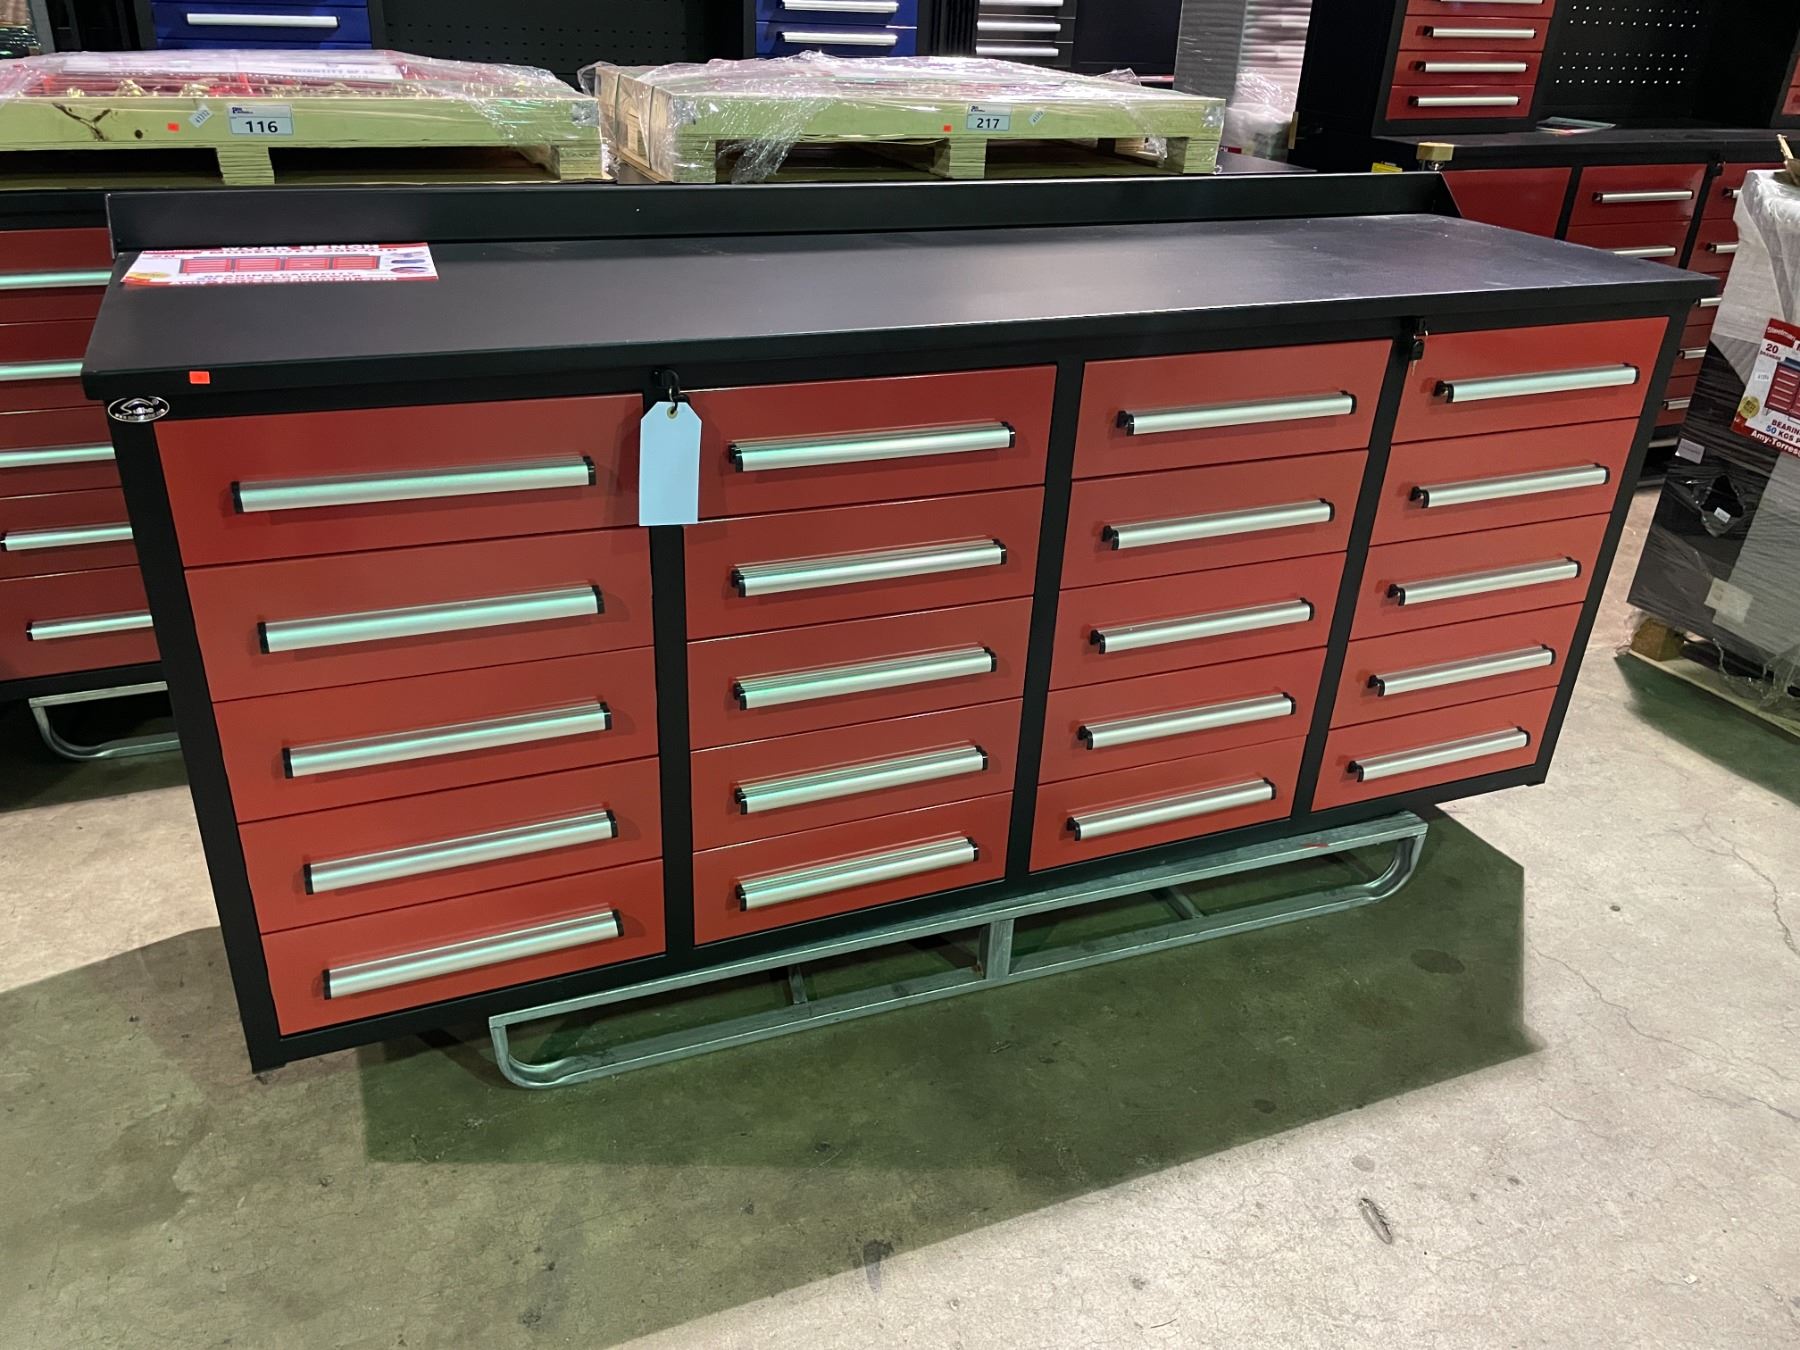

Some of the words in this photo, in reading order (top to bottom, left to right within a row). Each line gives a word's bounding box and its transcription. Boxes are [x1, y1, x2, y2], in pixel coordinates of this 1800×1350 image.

[245, 120, 279, 133] 116
[976, 117, 1000, 129] 217
[1765, 343, 1779, 354] 20
[1765, 424, 1777, 434] 50
[1778, 430, 1794, 442] KGS
[1771, 419, 1800, 436] BEARIN
